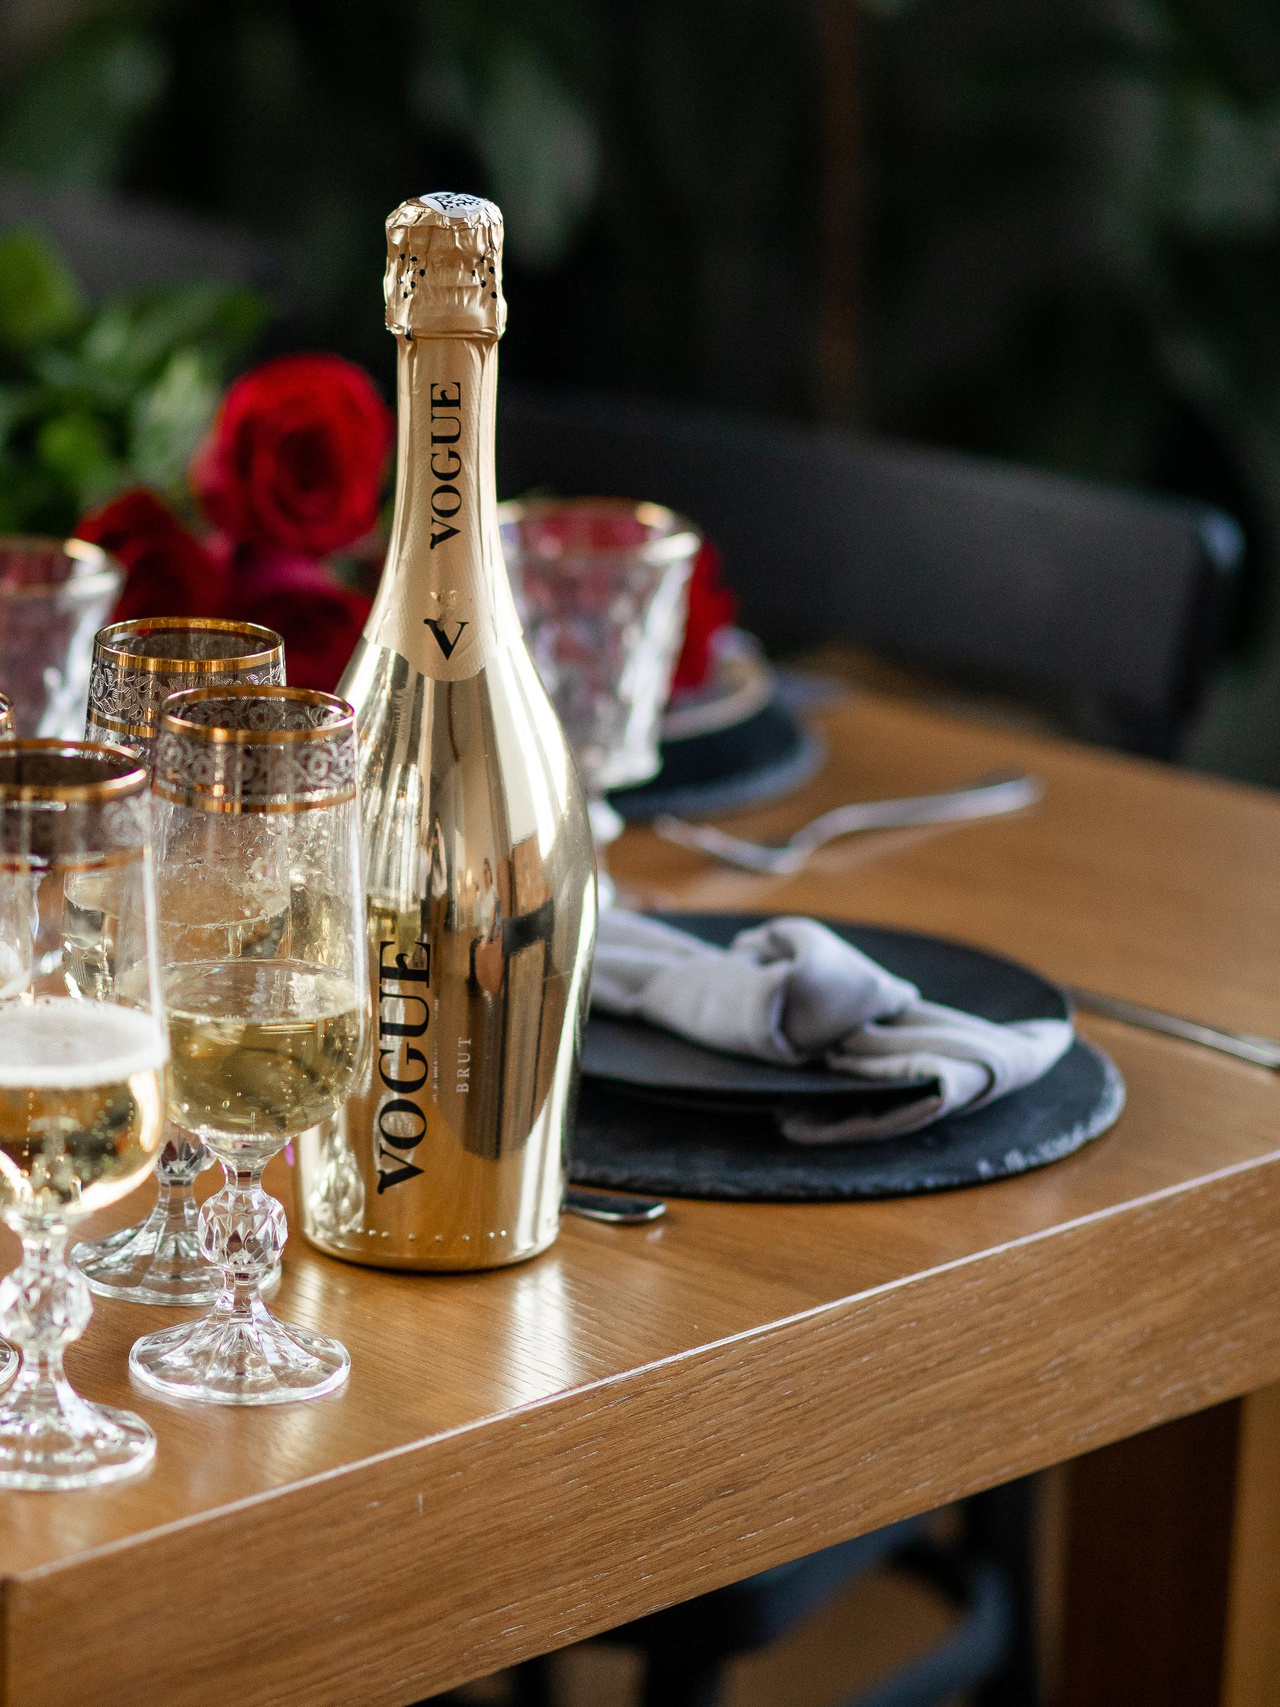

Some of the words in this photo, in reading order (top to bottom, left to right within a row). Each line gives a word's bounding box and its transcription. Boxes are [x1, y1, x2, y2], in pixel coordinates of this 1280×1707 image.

[429, 381, 462, 550] VOGUE
[423, 618, 469, 661] V
[377, 940, 432, 1196] VOGUE
[456, 1037, 472, 1094] BRUT
